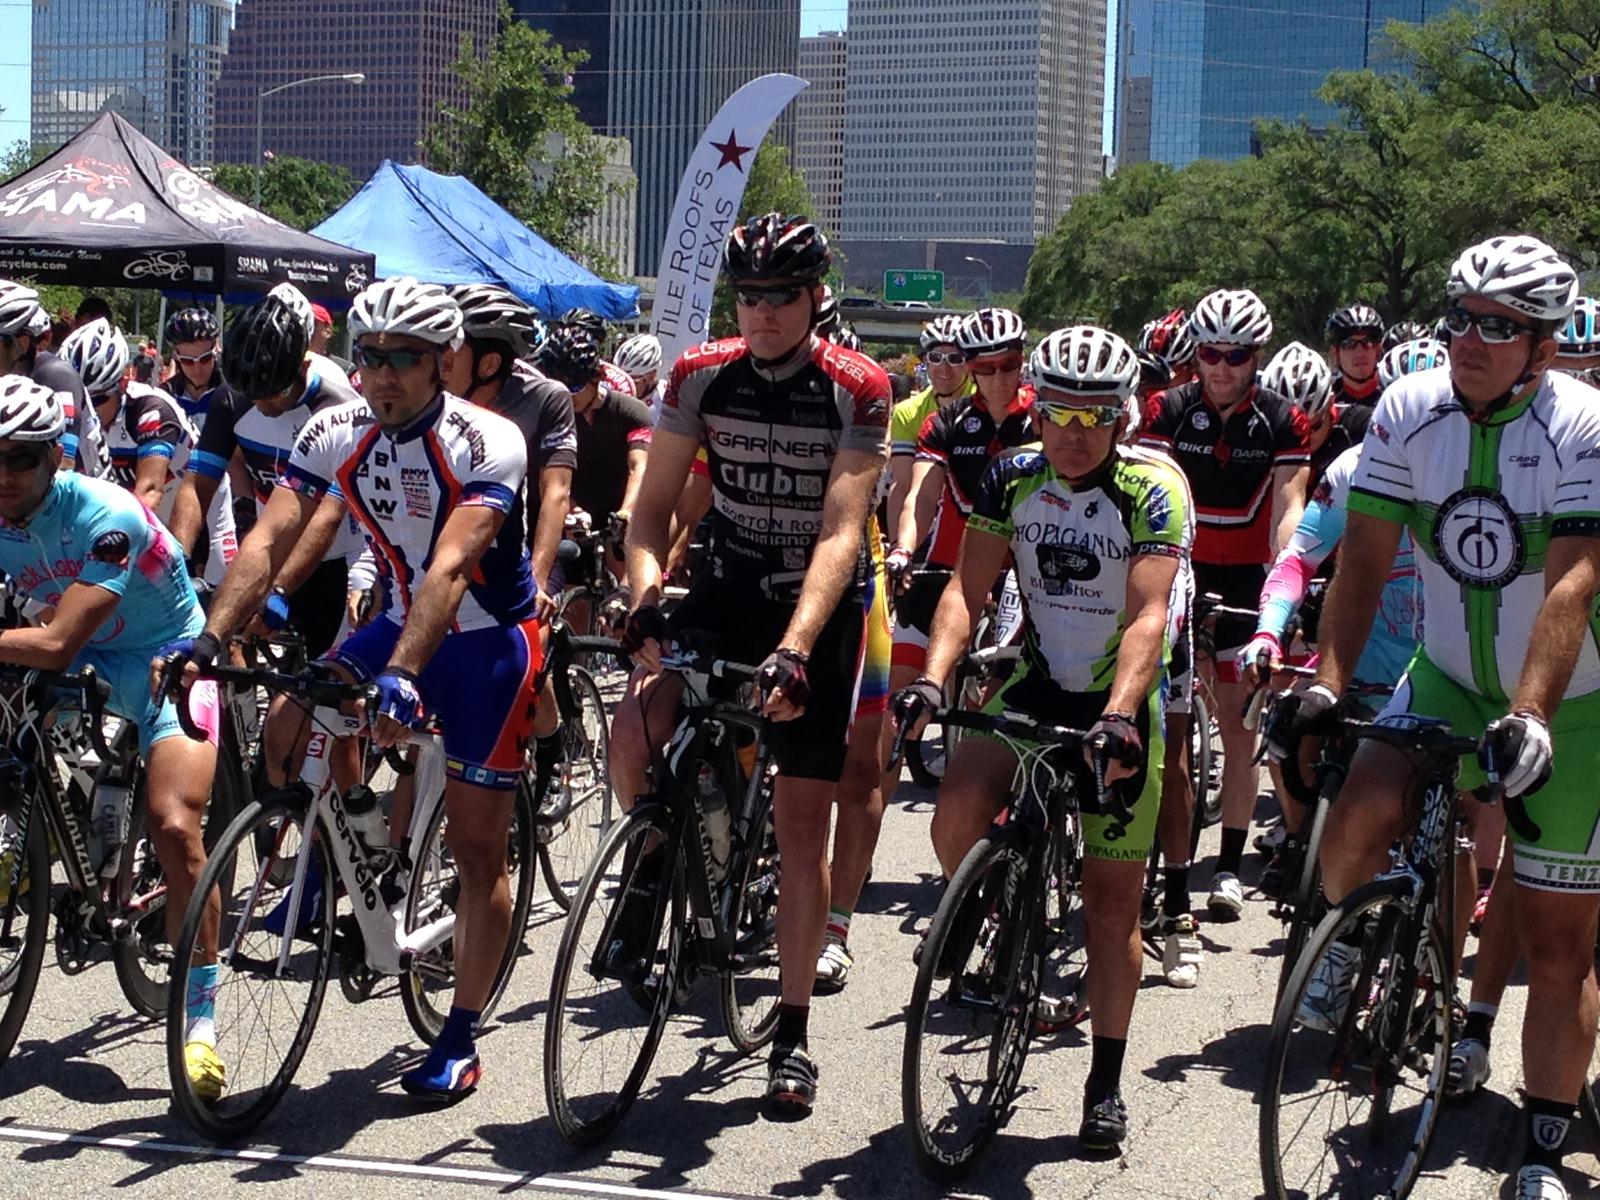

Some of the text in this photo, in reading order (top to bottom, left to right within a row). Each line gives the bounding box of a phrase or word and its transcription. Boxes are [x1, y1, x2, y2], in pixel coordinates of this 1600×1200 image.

[654, 169, 714, 339] TILE ROOFS
[688, 197, 735, 334] OF TEXAS
[297, 406, 368, 457] BNW AUTO
[953, 446, 986, 455] BIKE
[1178, 441, 1215, 455] BIKE
